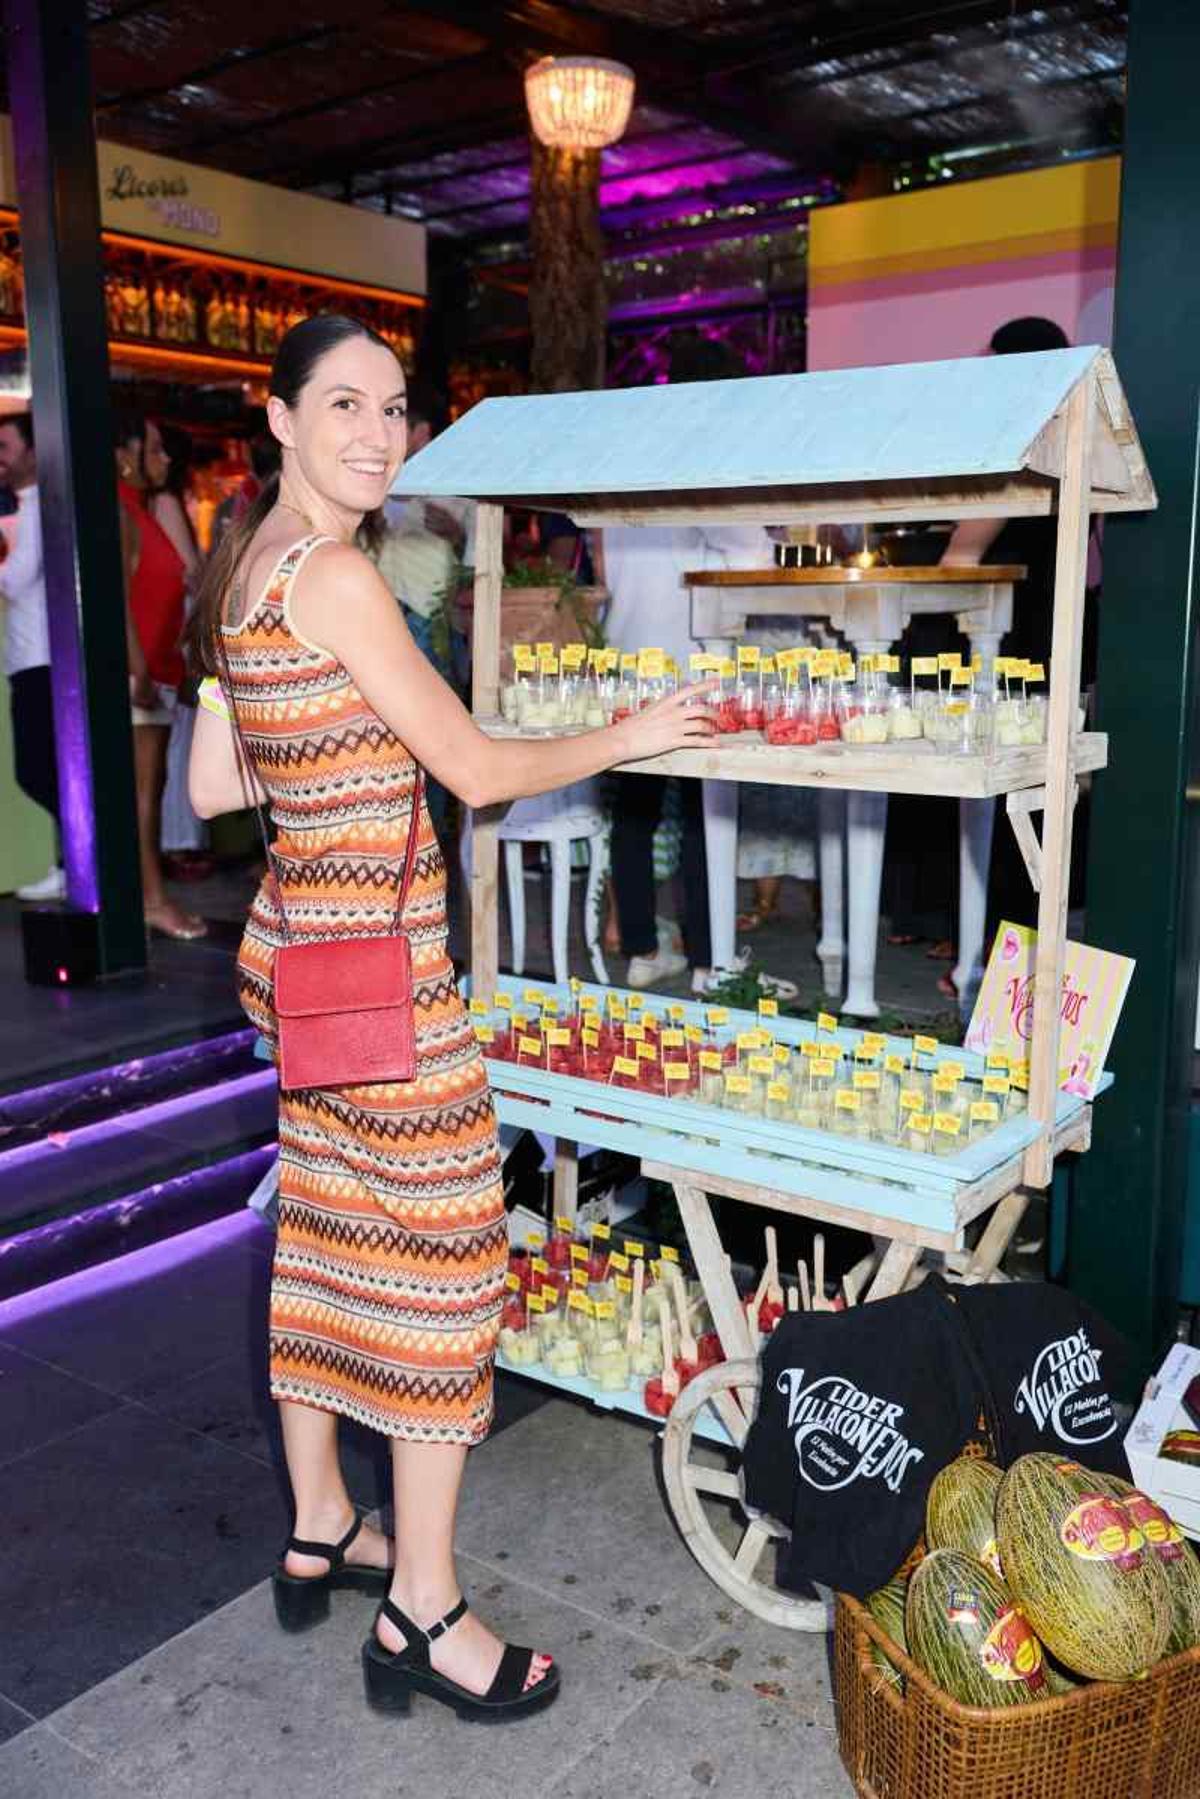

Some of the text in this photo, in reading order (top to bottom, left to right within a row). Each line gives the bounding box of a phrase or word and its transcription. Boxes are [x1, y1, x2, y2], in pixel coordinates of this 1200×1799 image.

[107, 165, 189, 200] Licores
[1048, 1327, 1090, 1373] LIDE
[776, 1367, 925, 1492] VILLACONEJOS
[828, 1385, 905, 1429] LIDER
